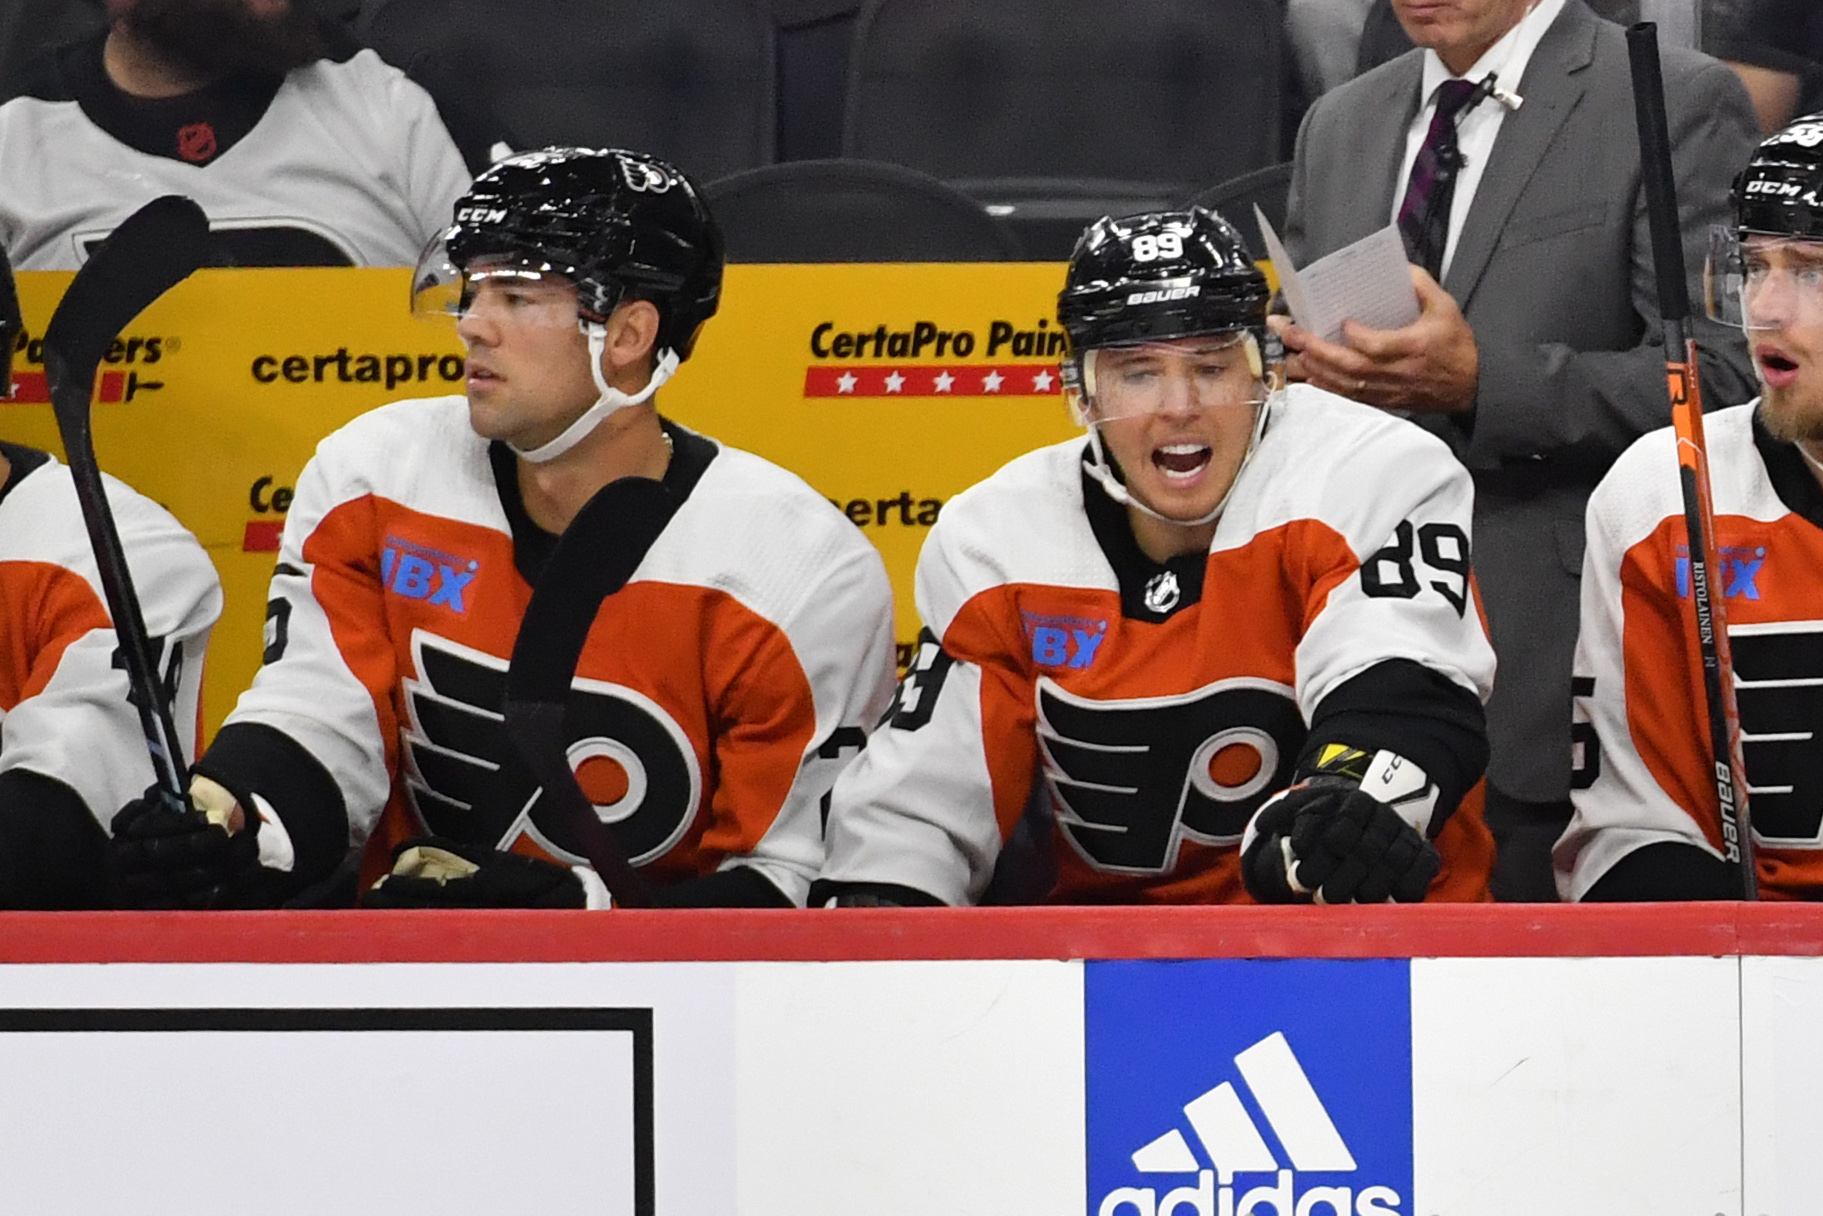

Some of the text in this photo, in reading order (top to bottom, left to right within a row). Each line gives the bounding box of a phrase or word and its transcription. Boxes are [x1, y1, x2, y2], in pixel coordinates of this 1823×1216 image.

[457, 207, 508, 224] CCM
[1131, 232, 1184, 262] 89
[1126, 286, 1201, 305] BAUER
[810, 320, 976, 358] CertaPro
[381, 546, 476, 614] IBX
[1360, 518, 1470, 620] 89
[1693, 561, 1713, 645] RISTOLAINEN
[1715, 760, 1741, 864] BAUER
